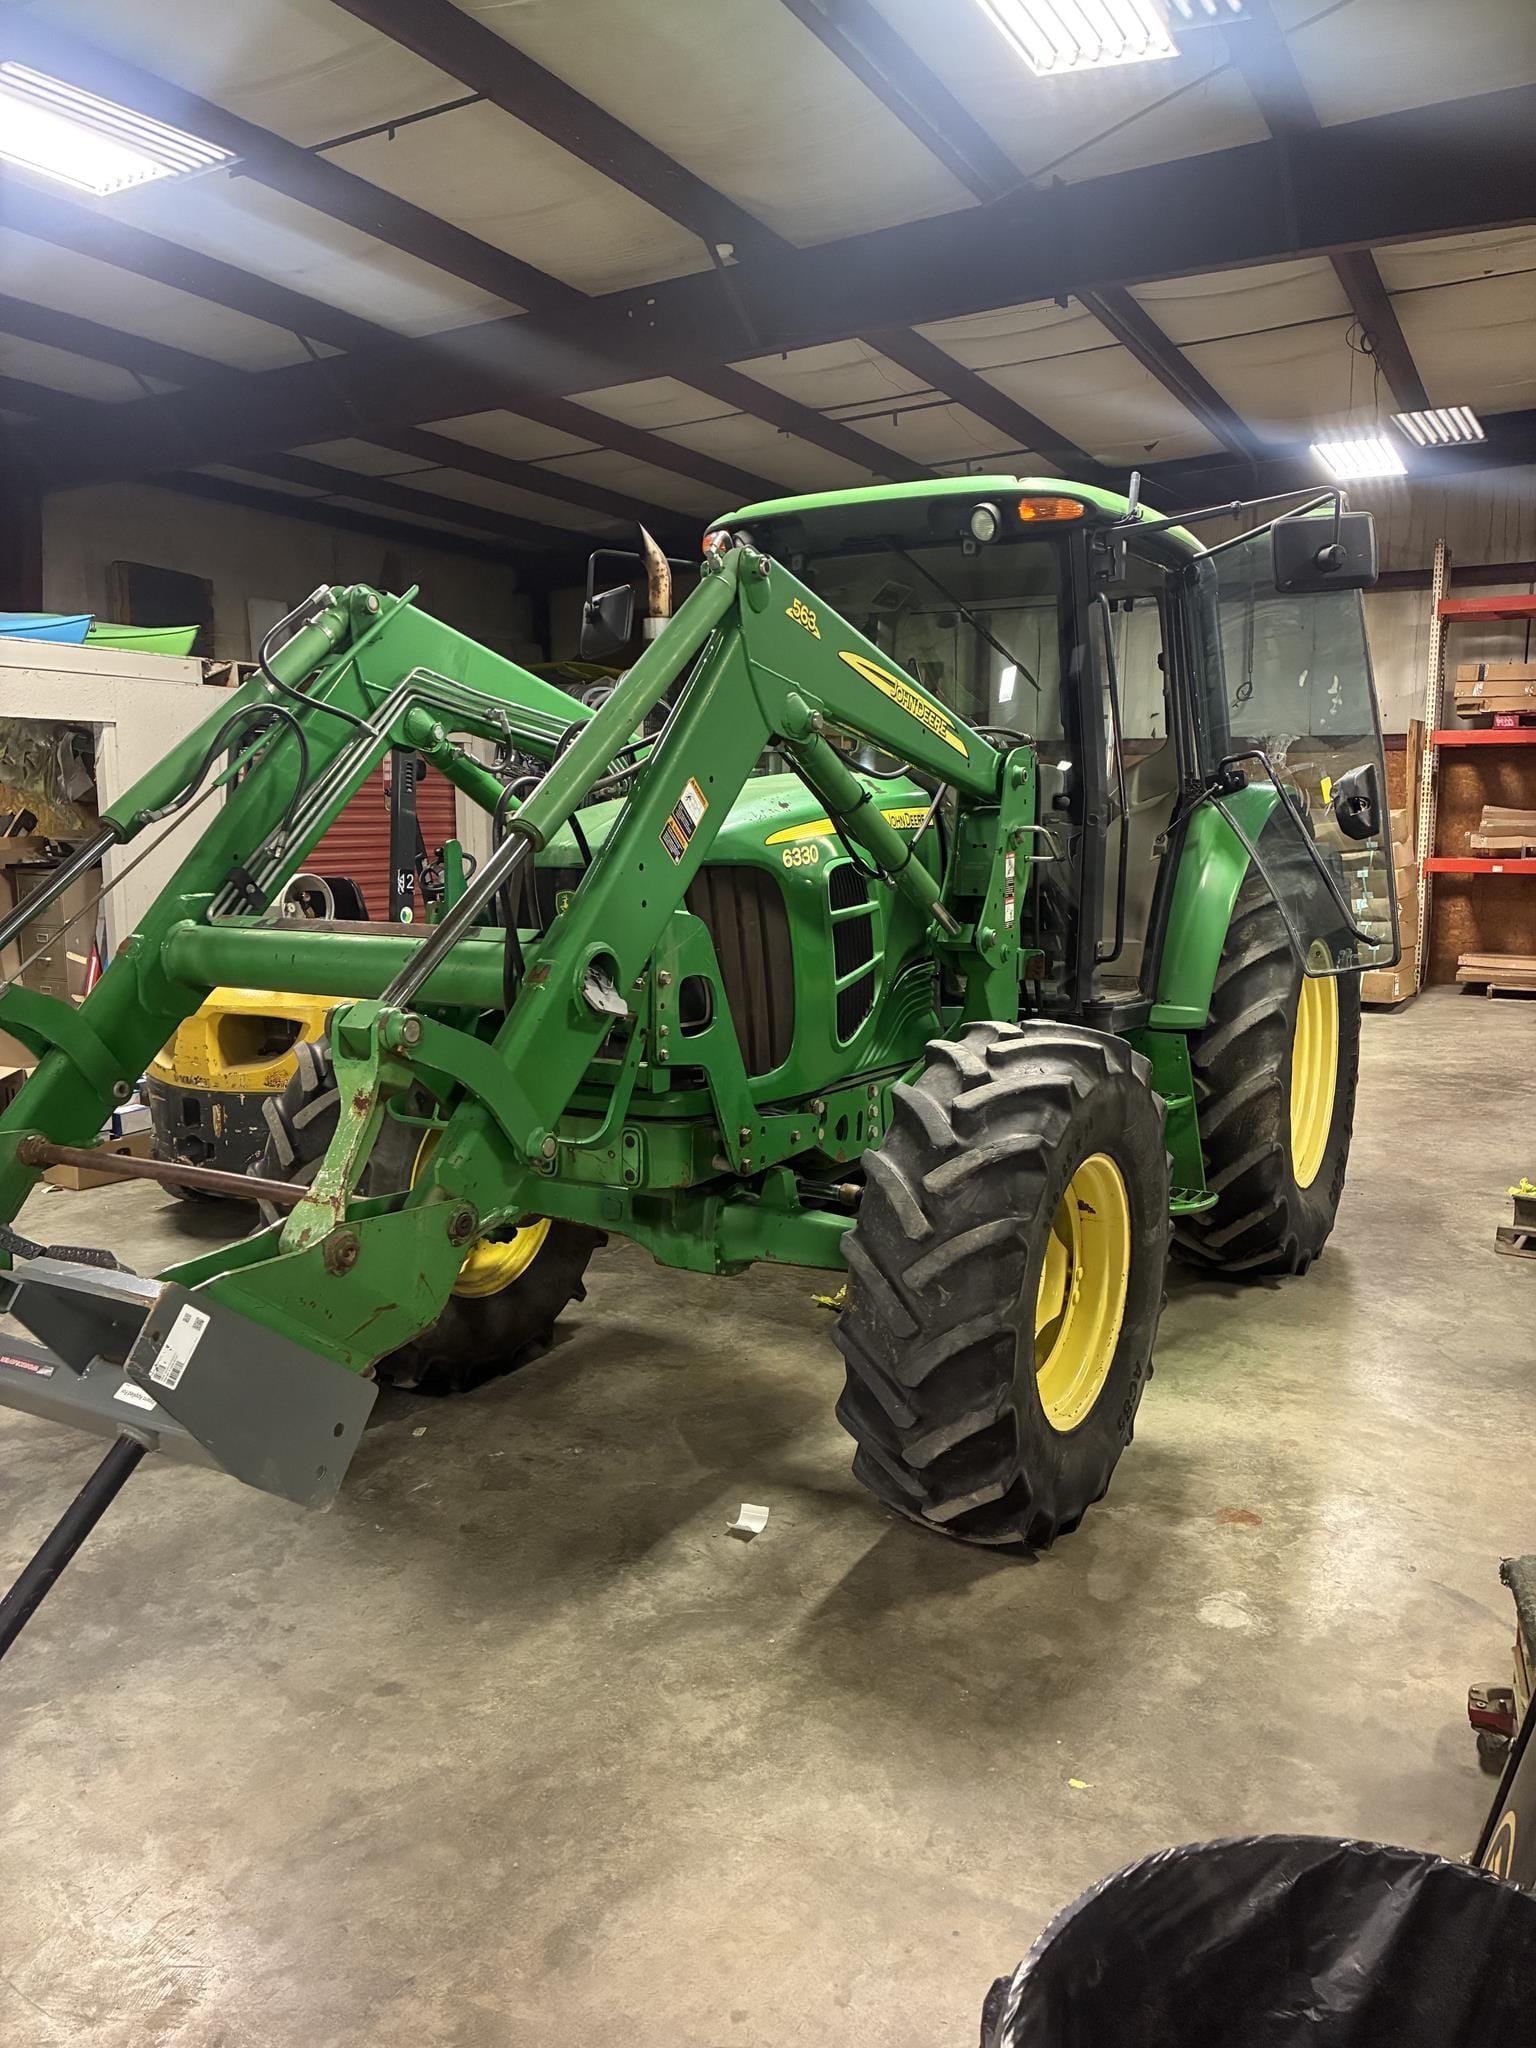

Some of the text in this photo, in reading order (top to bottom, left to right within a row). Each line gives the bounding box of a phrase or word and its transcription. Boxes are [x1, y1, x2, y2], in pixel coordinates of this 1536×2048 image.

[792, 597, 817, 632] 563
[890, 680, 948, 738] JOHN DEERE
[888, 813, 906, 828] JOHN
[782, 844, 819, 868] 6330
